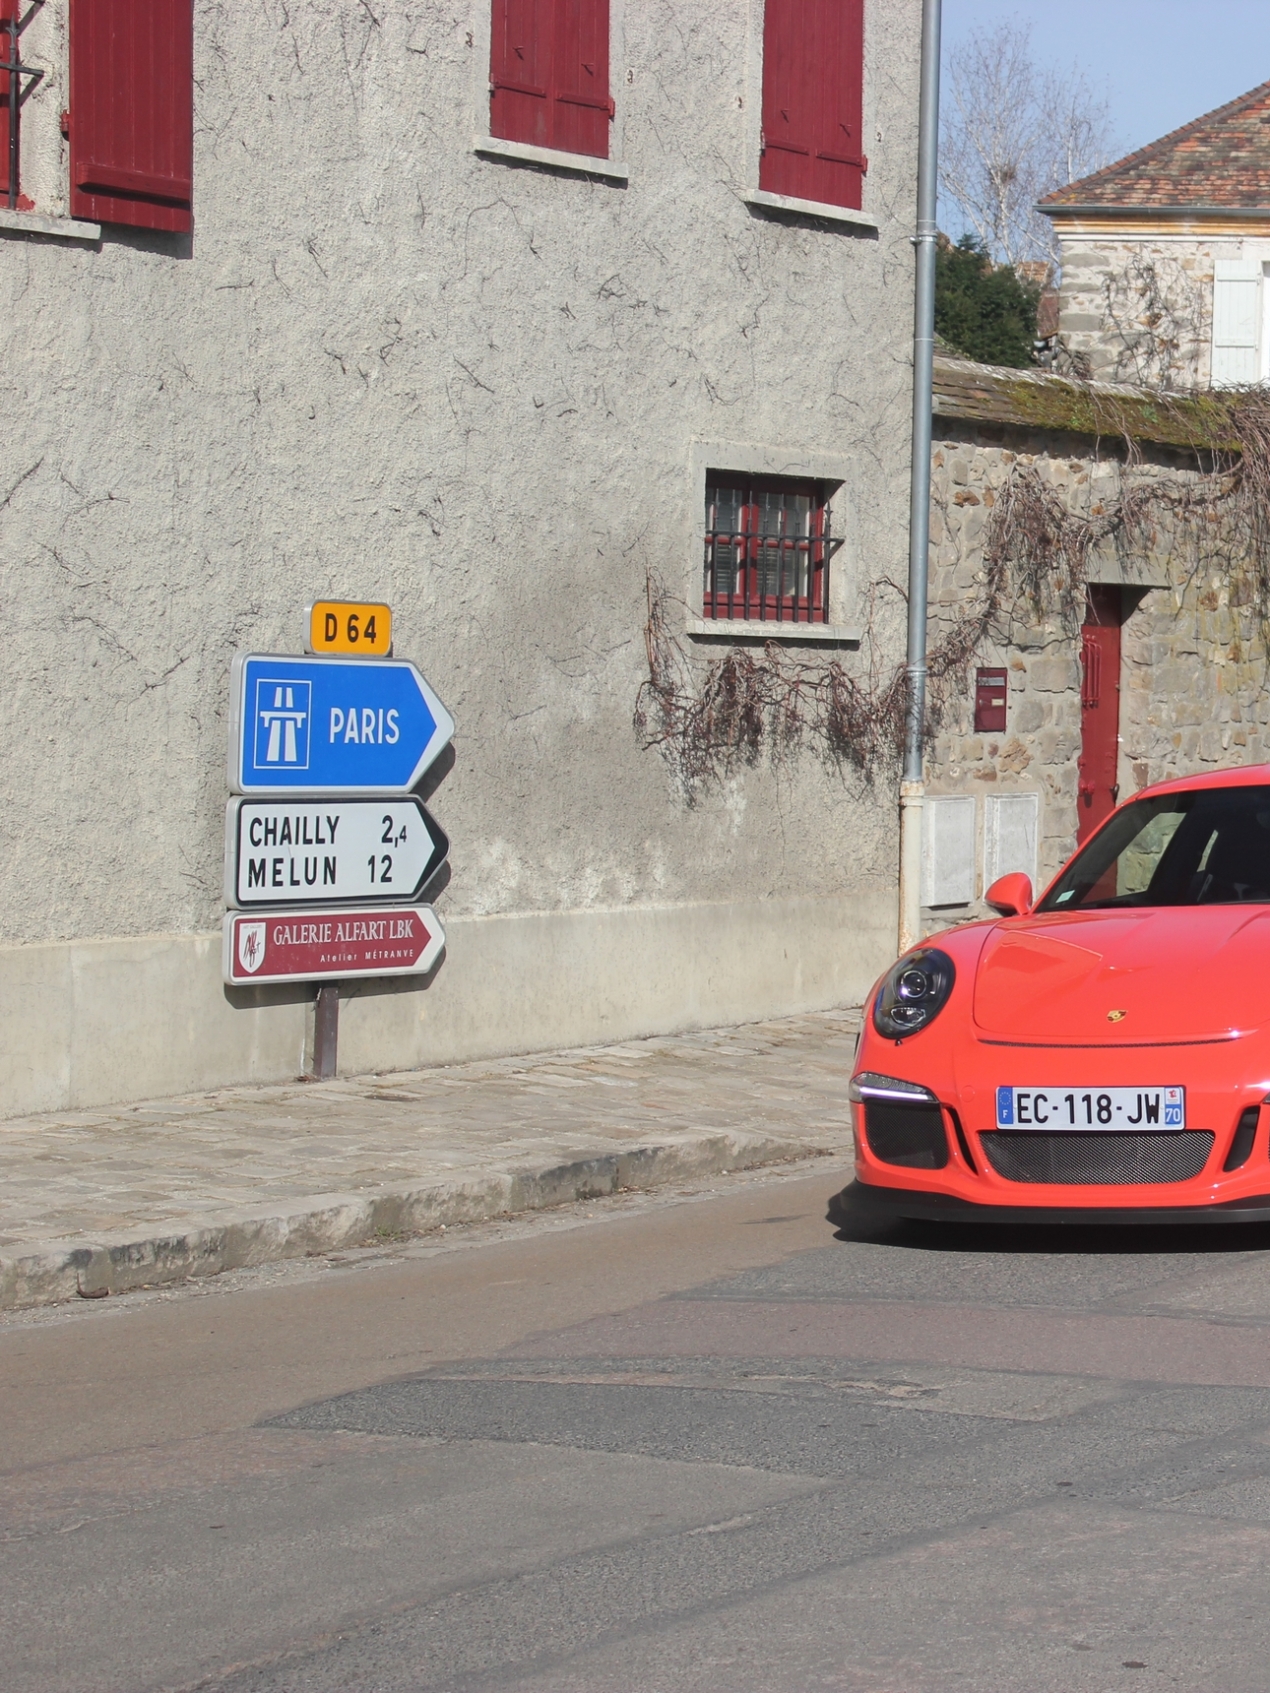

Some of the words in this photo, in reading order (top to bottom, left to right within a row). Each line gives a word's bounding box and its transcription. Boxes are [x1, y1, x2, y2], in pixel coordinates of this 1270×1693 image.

[324, 612, 338, 642] D
[346, 613, 377, 644] 64
[329, 707, 400, 744] PARIS
[249, 815, 340, 847] CHAILLY
[381, 814, 407, 848] 2,4
[248, 856, 337, 888] MELUN
[367, 854, 393, 883] 12
[273, 923, 332, 945] GALERIE
[335, 920, 387, 942] ALFART
[389, 919, 414, 939] LBK
[320, 953, 358, 963] Atelier
[1002, 1109, 1009, 1118] F
[1017, 1093, 1160, 1124] EC-118-JW
[1165, 1108, 1181, 1122] 70
